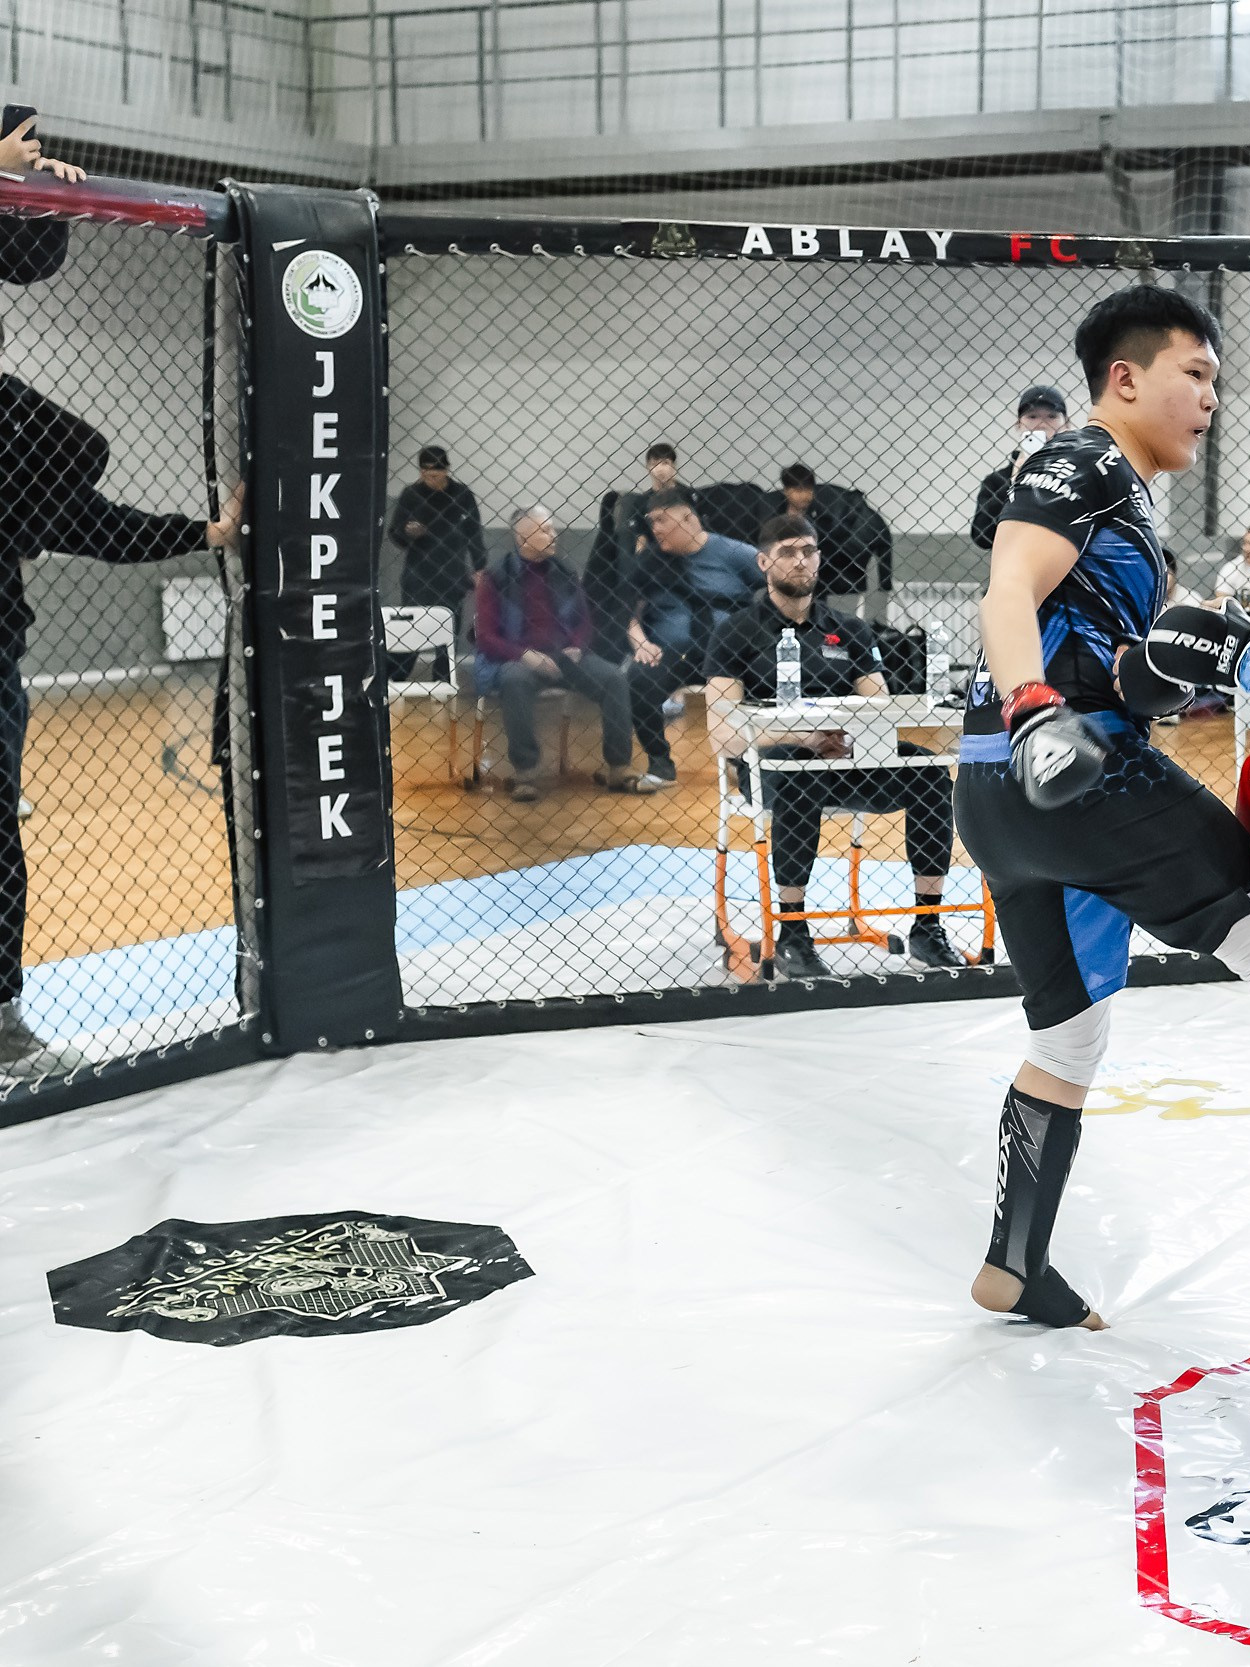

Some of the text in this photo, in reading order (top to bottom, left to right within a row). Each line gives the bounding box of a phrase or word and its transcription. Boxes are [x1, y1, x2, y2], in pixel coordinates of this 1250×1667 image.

[740, 224, 1079, 262] ABLAY FC
[310, 350, 342, 641] JEKPE
[317, 674, 353, 840] JEK
